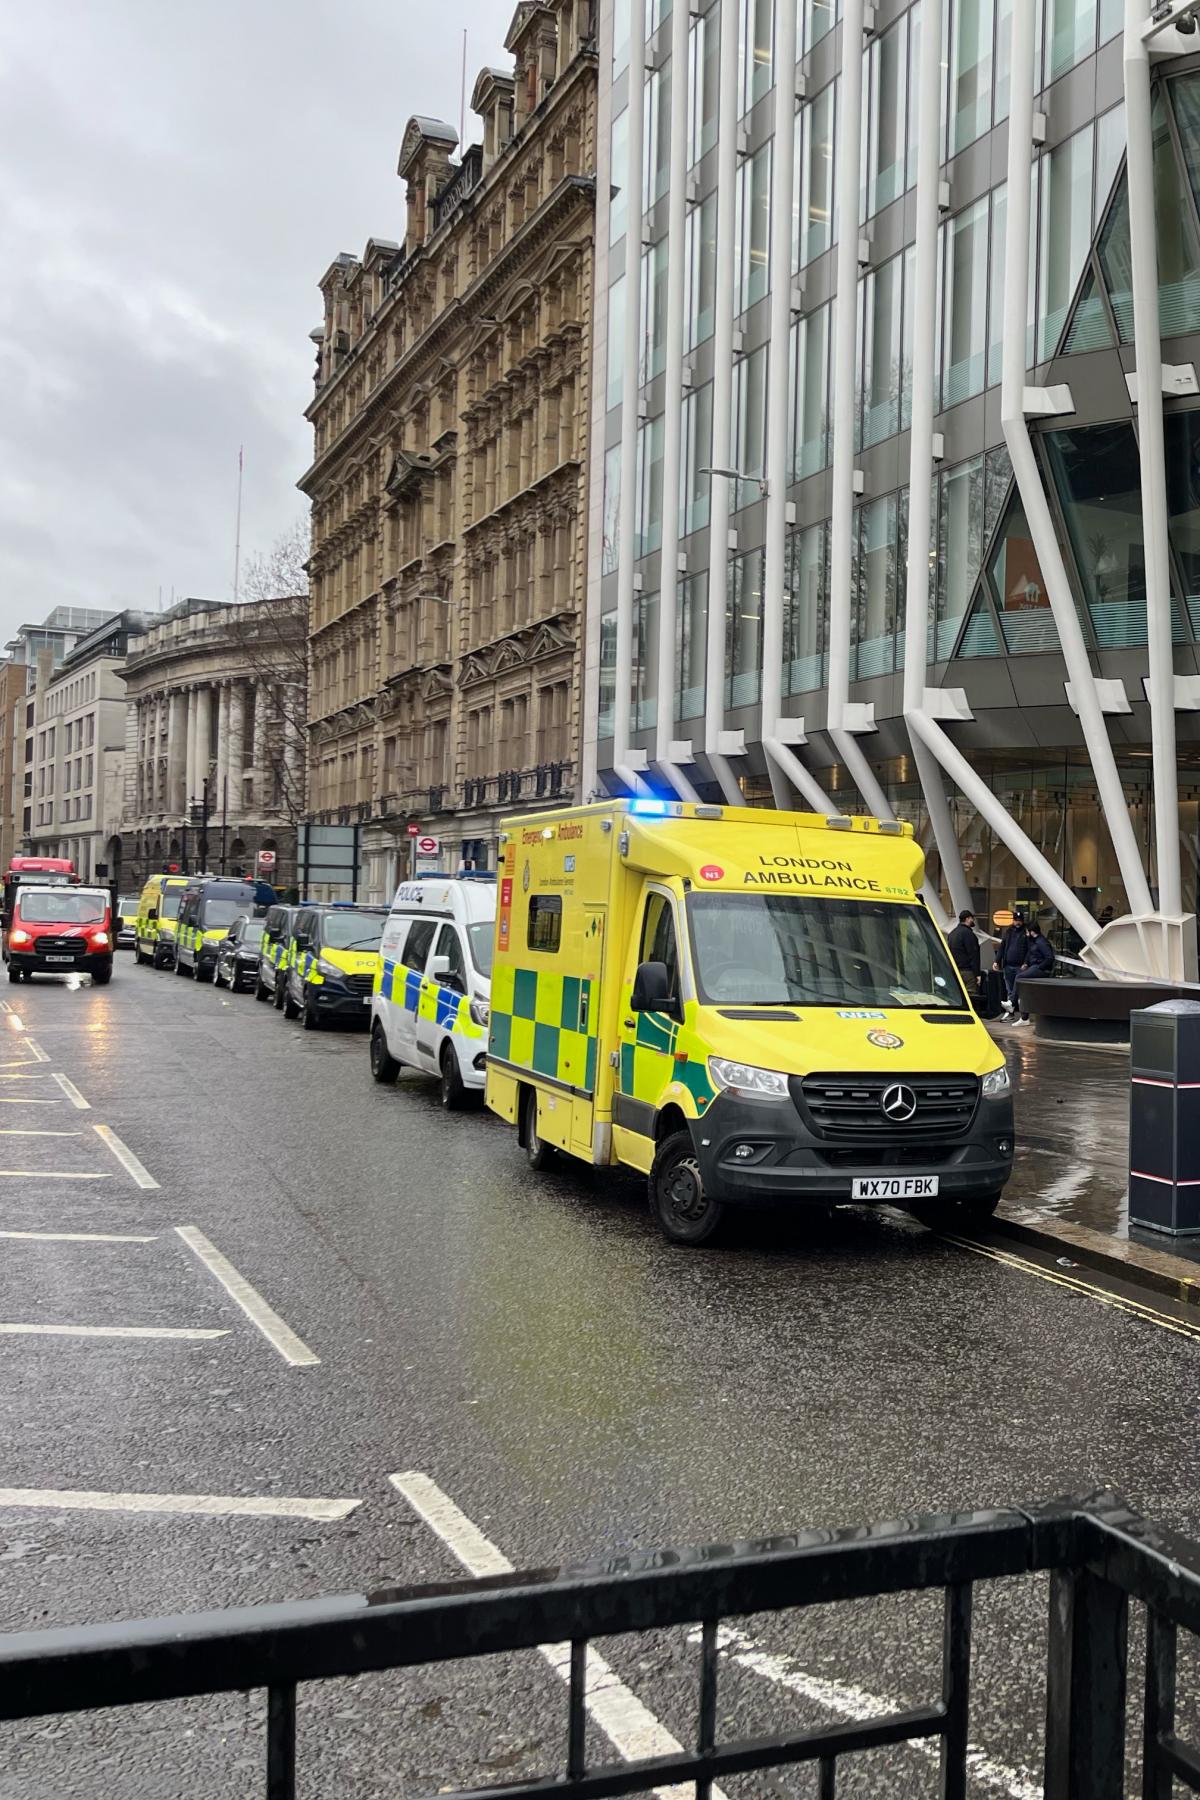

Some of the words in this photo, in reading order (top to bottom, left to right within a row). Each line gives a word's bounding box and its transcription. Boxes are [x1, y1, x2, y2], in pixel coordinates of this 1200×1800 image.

[759, 856, 853, 871] LONDON
[743, 871, 881, 892] AMBULANCE
[838, 1011, 885, 1019] NHS
[859, 1180, 900, 1196] WX70
[904, 1178, 933, 1194] FBK
